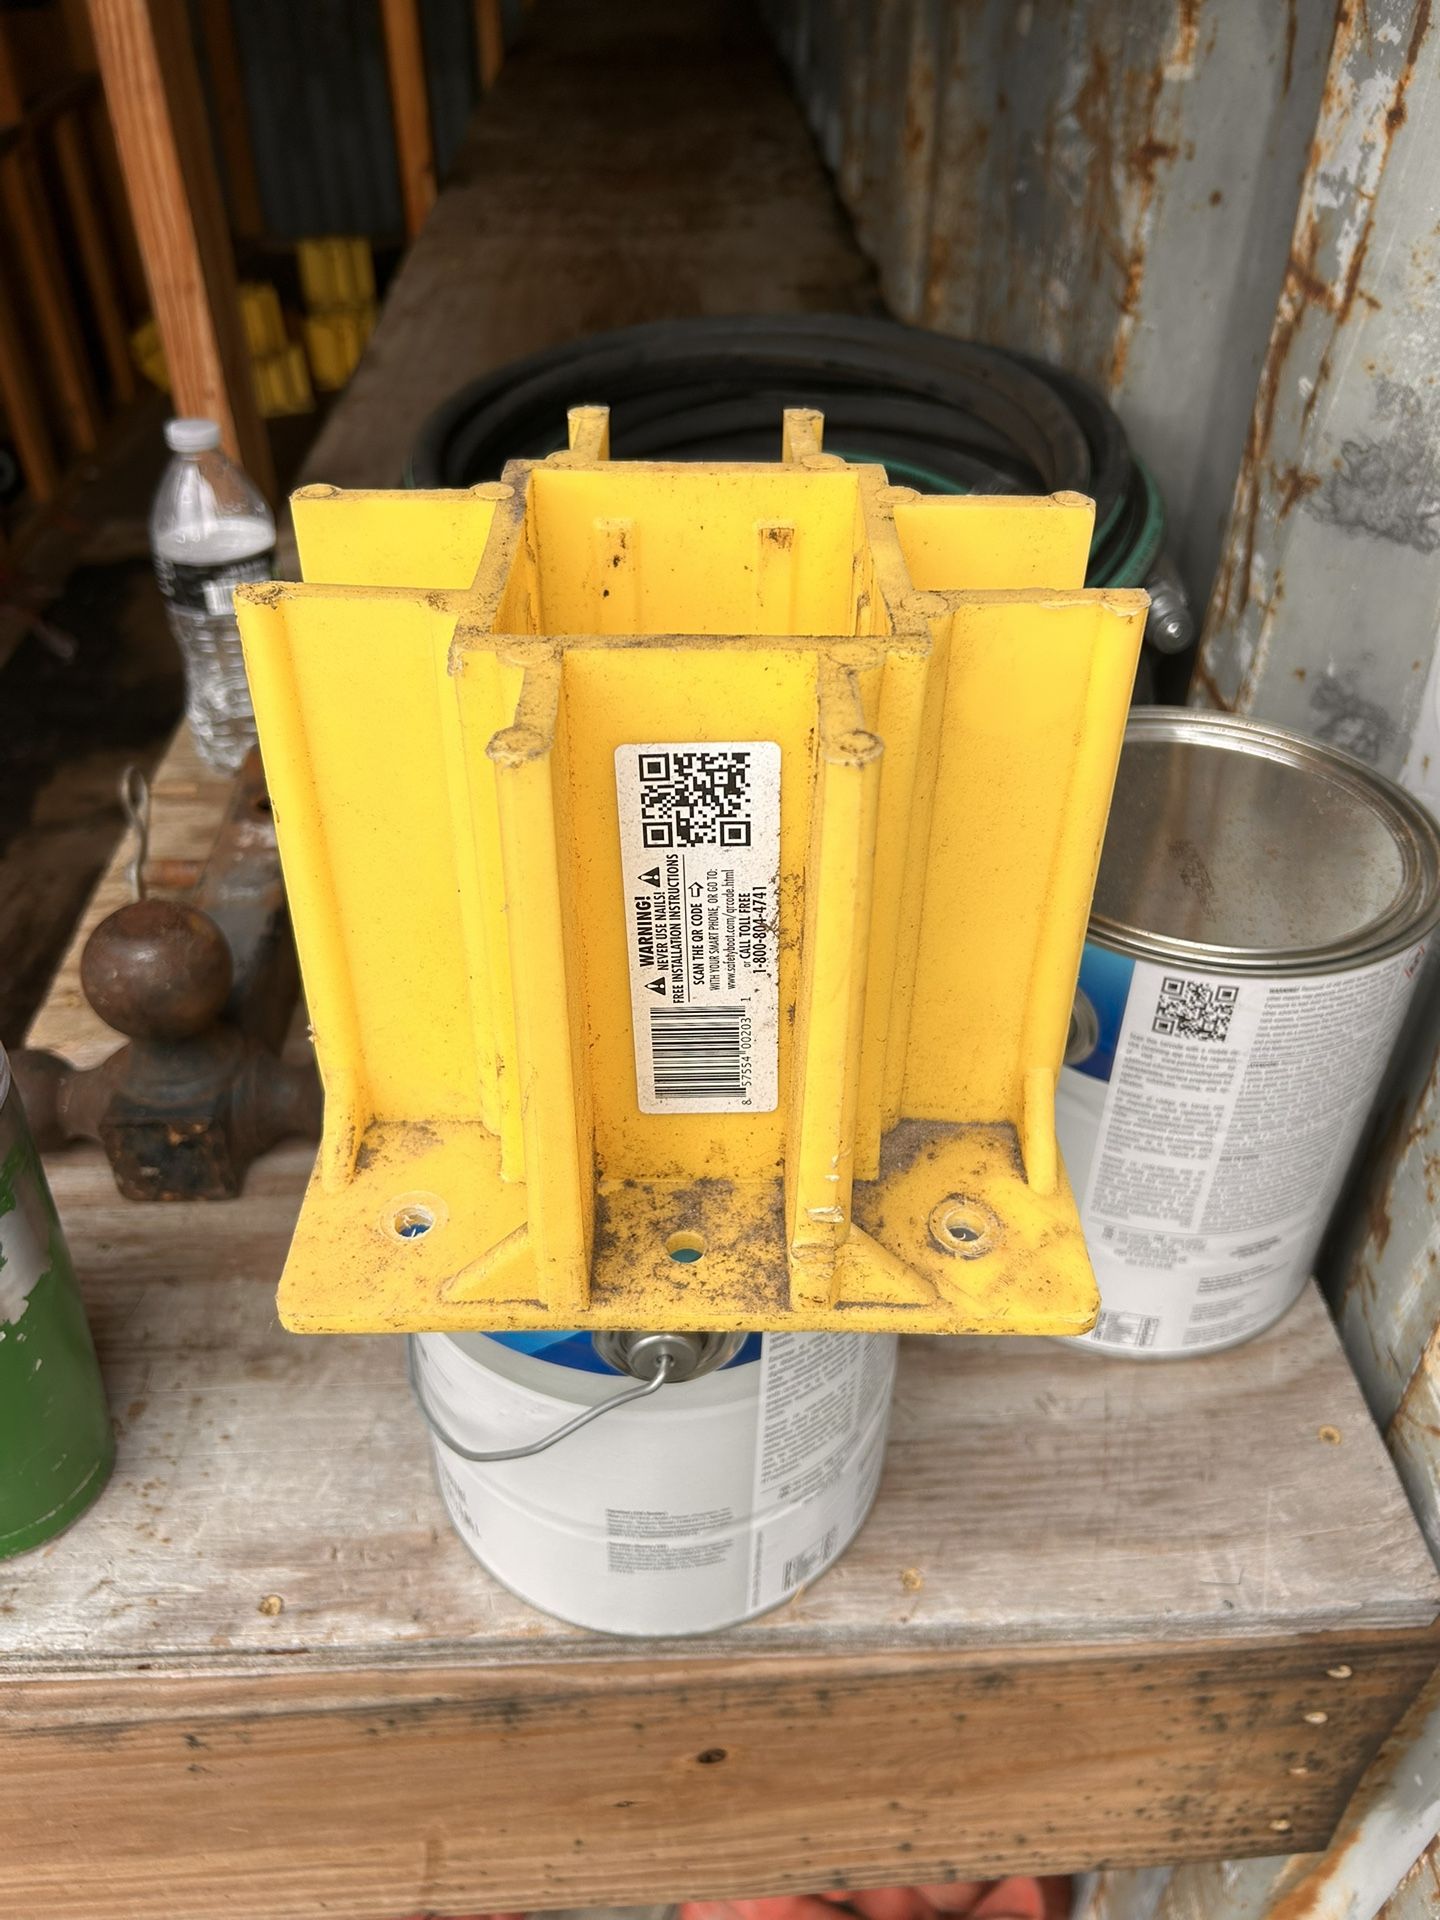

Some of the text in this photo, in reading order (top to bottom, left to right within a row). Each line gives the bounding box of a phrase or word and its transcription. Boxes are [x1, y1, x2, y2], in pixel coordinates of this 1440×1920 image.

[634, 896, 655, 968] WARNING!
[653, 891, 669, 971] NEVER USE NAILS!
[666, 853, 685, 1004] FREE INSTALLATION INSTRUCTIONS
[706, 868, 721, 991] WITH YOUR SMART PHONE, OR GO TO:
[721, 869, 738, 990] www.safetyboot.com/qrcode.html
[738, 892, 750, 914] FREE
[738, 915, 751, 937] TOLL
[752, 886, 767, 974] 1-800-804-4741
[690, 903, 705, 985] SCAN THE QR CODE
[739, 938, 751, 959] CALL
[740, 1017, 752, 1050] 00203
[741, 1056, 752, 1087] 57554
